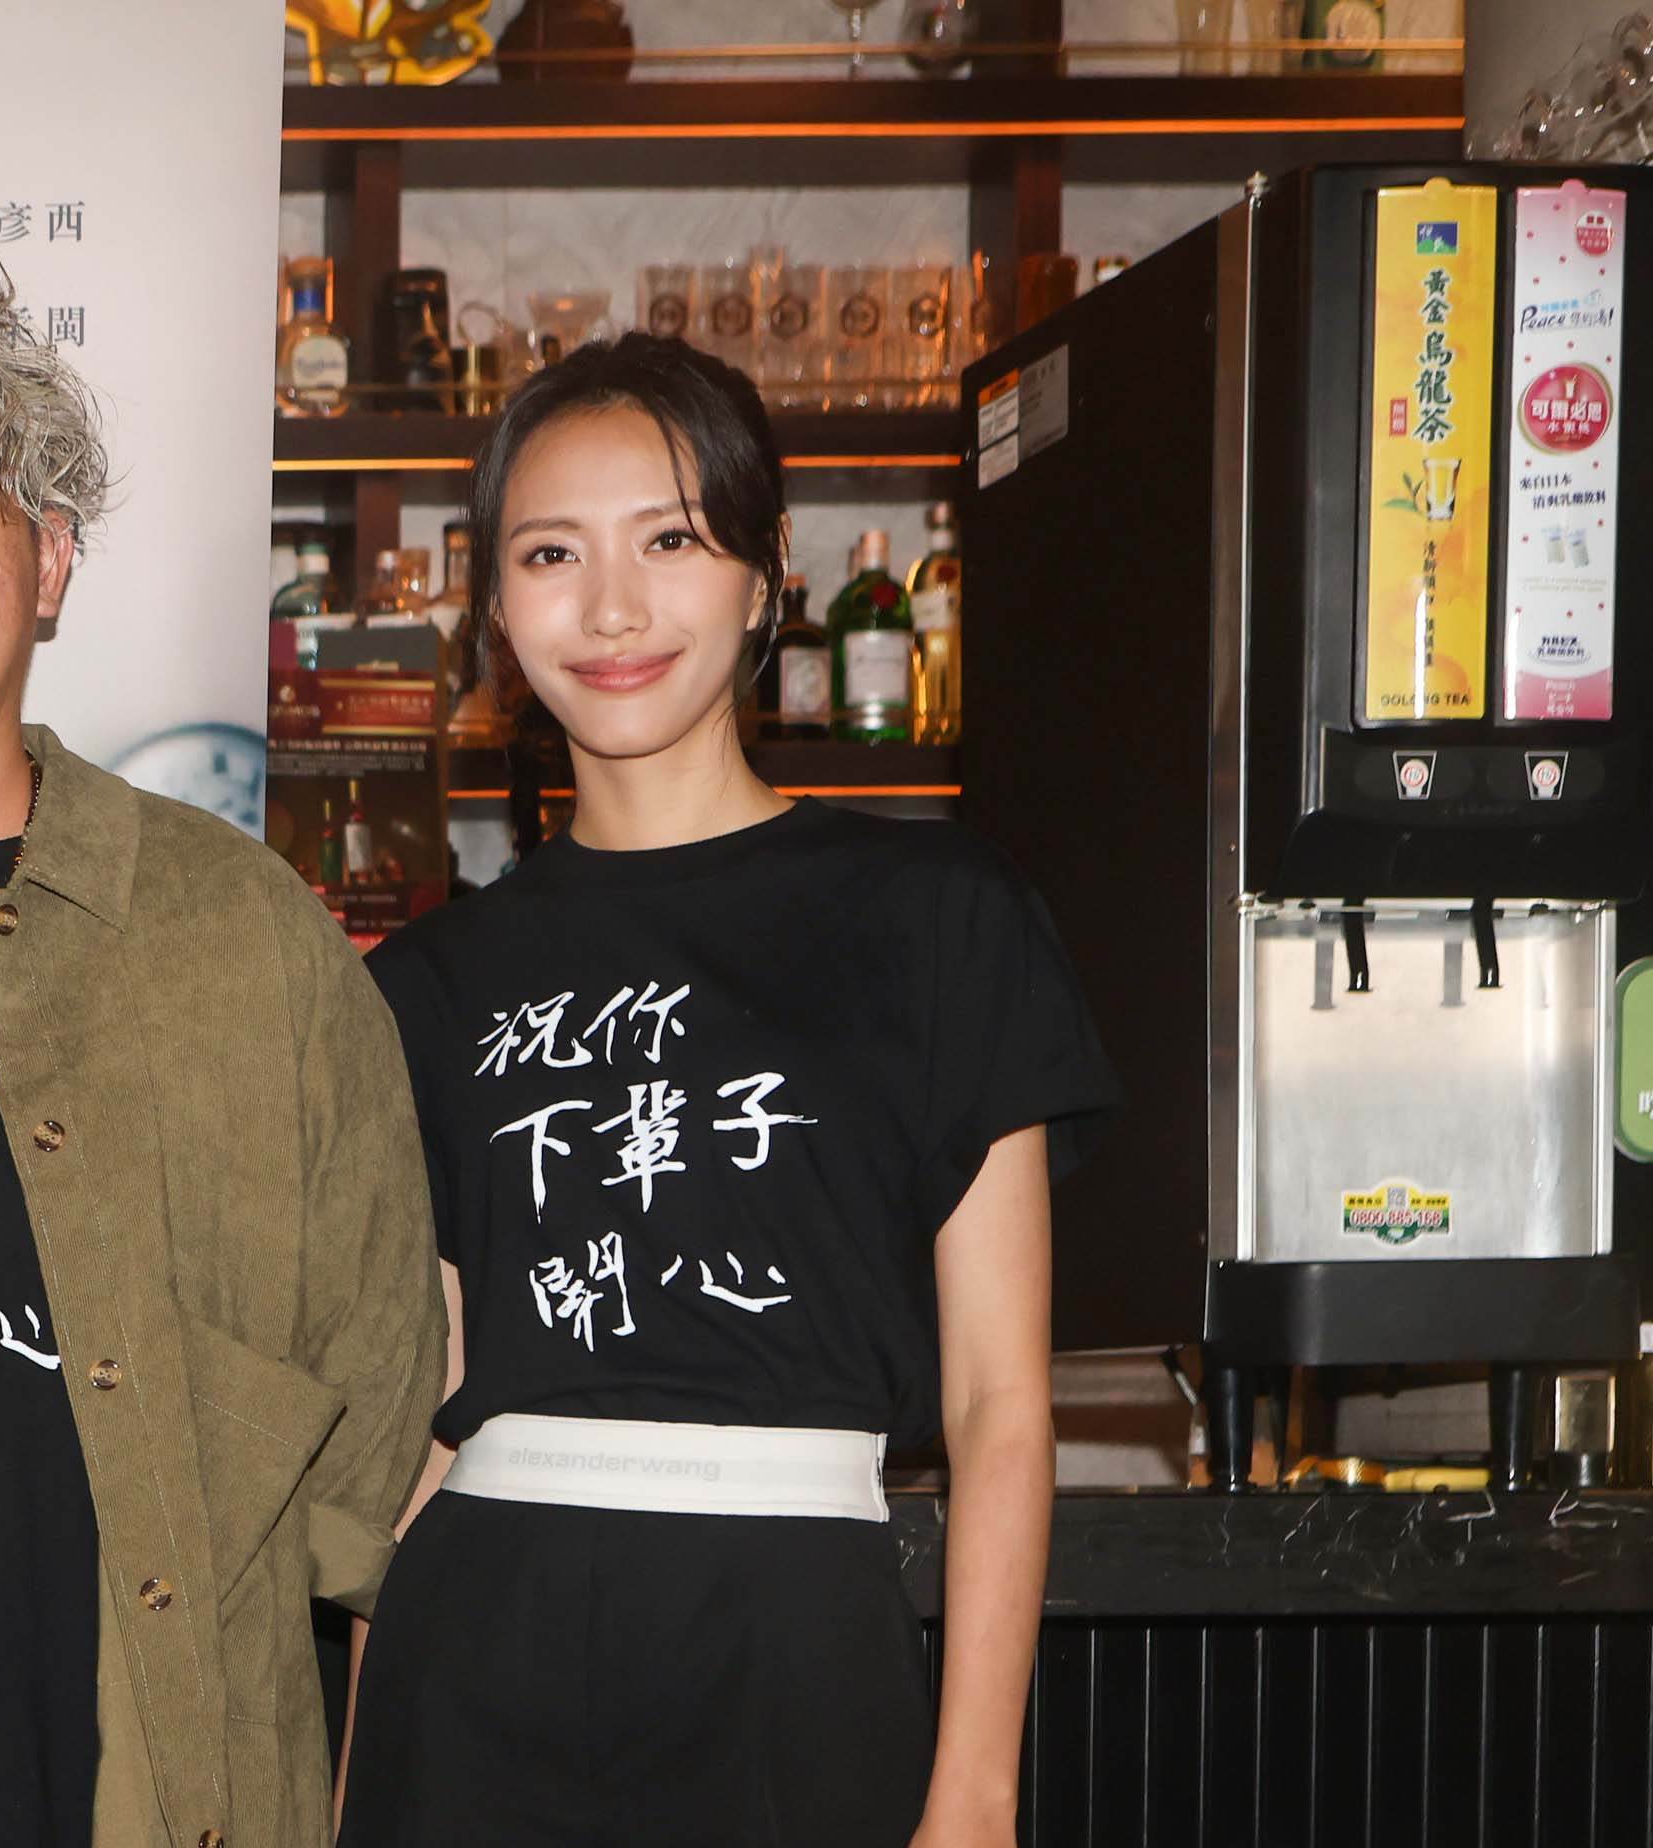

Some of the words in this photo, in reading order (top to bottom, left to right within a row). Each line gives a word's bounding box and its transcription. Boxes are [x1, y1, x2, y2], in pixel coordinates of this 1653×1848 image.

[1413, 269, 1453, 443] 黃金烏龍茶
[474, 980, 692, 1077] 祝你
[489, 1071, 819, 1224] 下輩子
[529, 1231, 792, 1352] 開心
